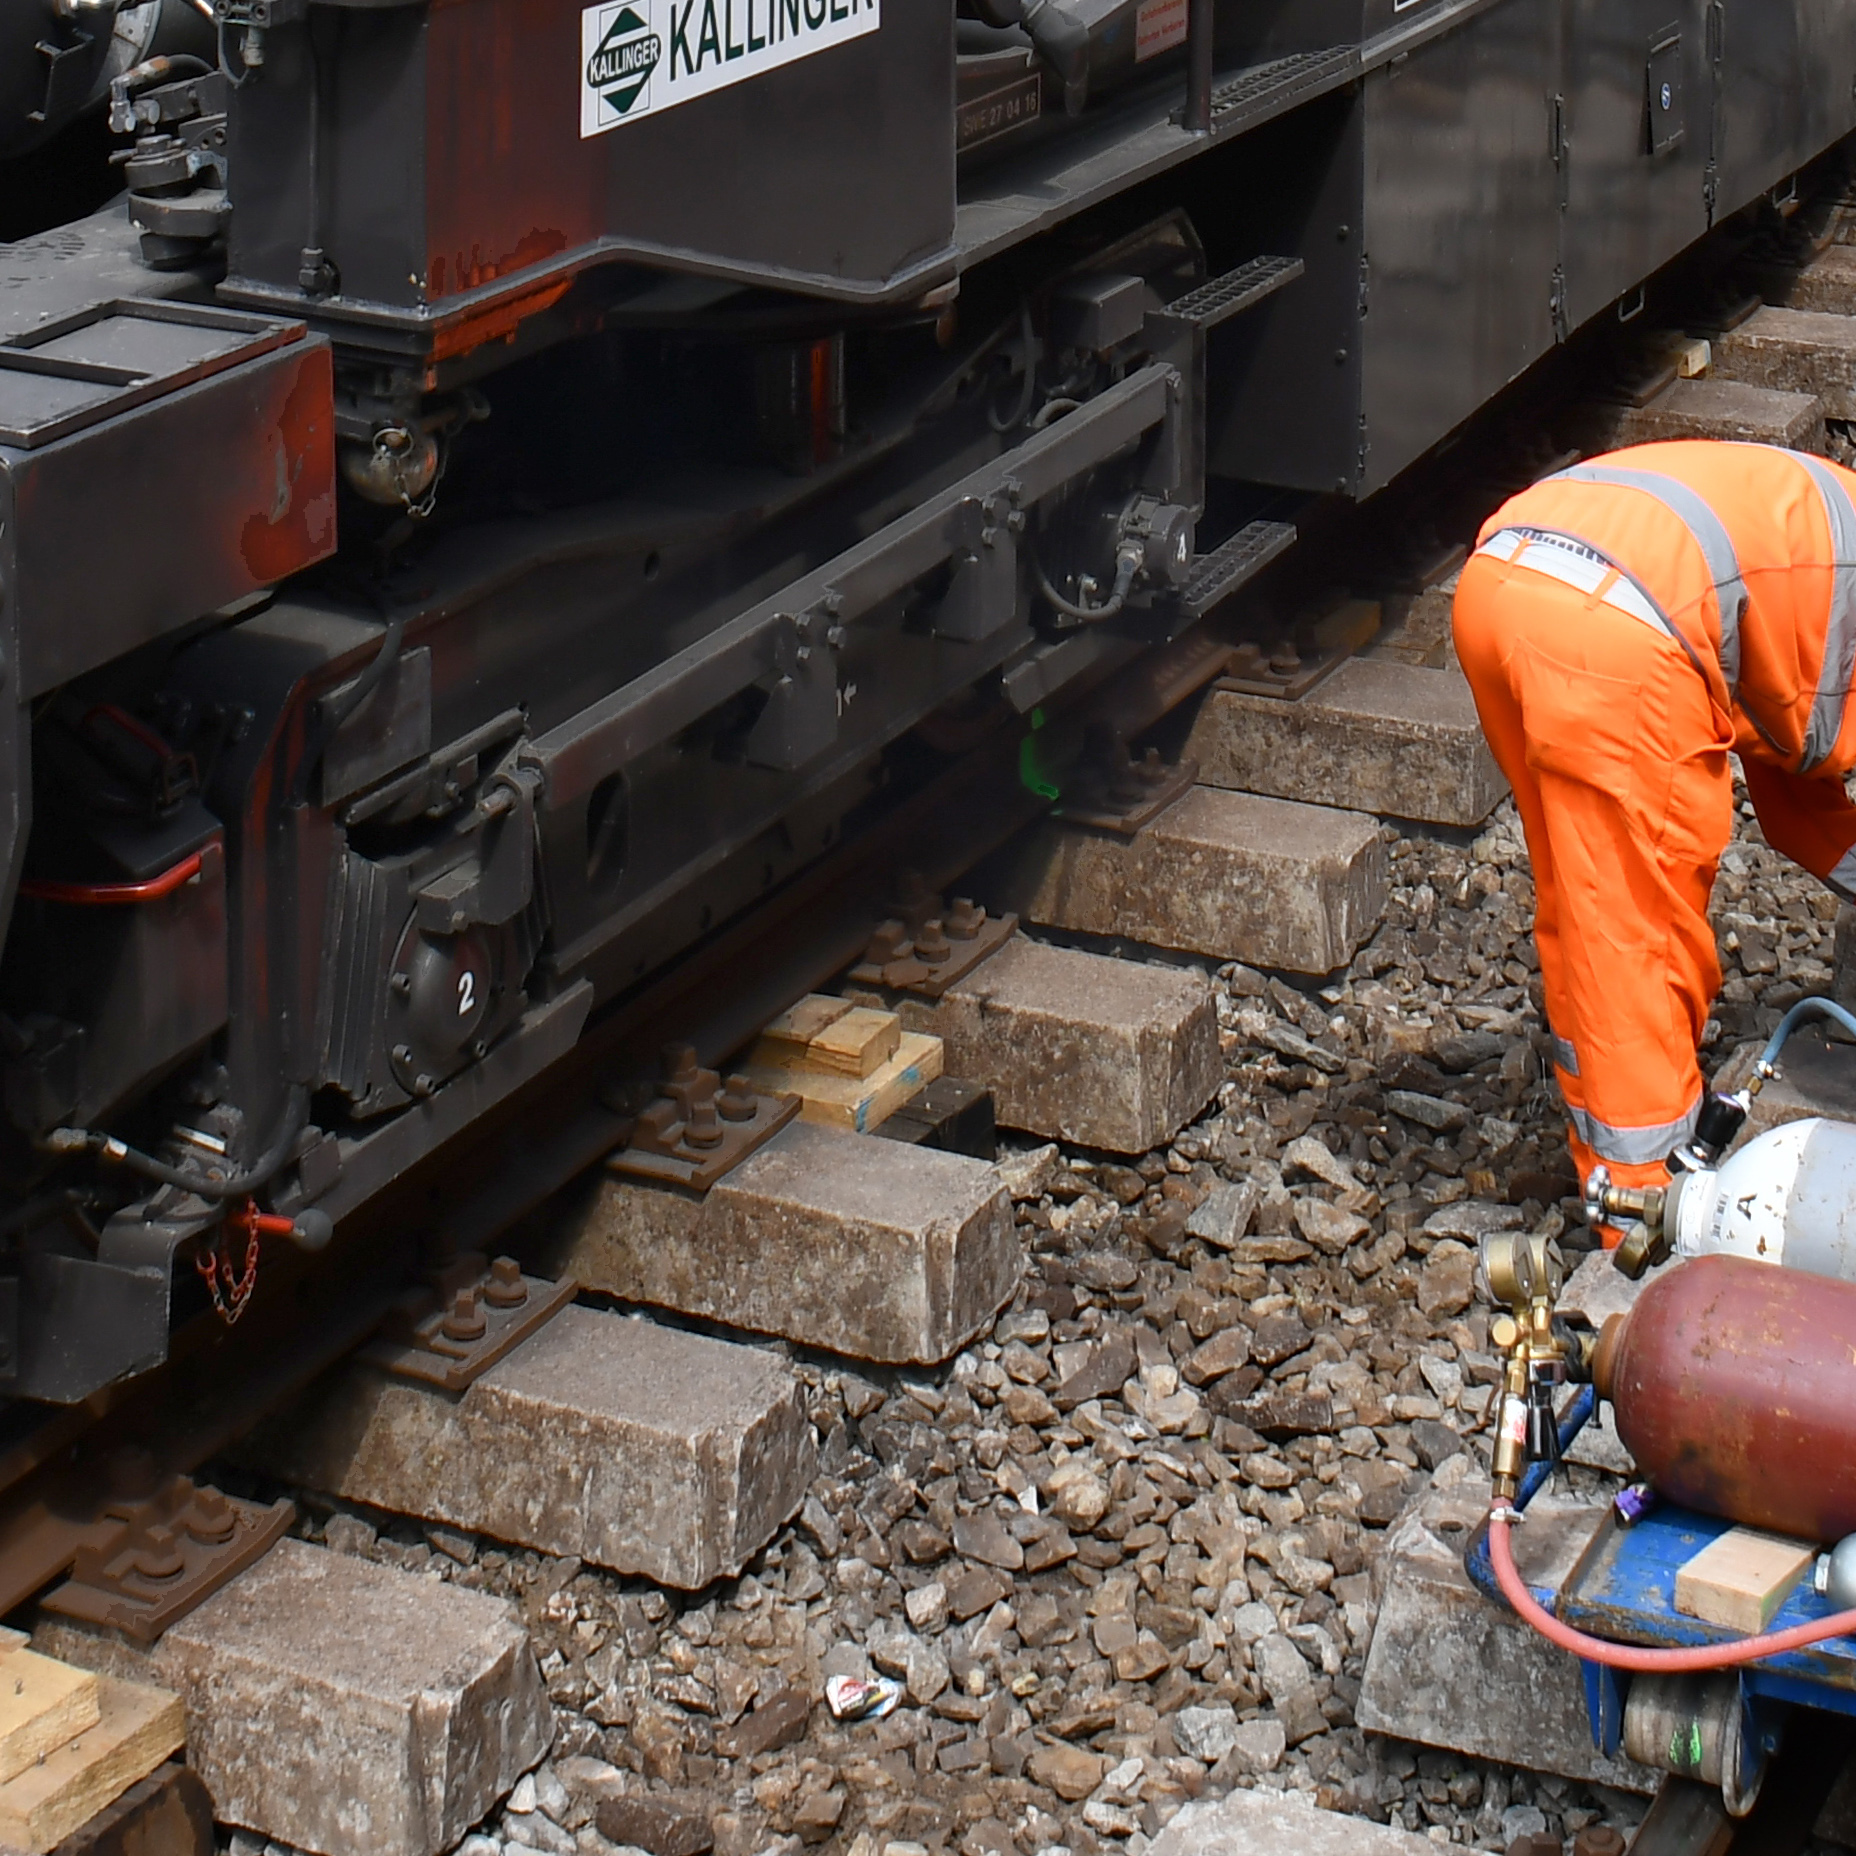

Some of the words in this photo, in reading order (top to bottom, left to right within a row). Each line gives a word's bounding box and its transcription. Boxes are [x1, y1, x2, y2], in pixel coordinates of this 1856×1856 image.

[590, 36, 659, 84] KALLINGER
[458, 971, 475, 1016] 2
[1737, 1193, 1758, 1221] A
